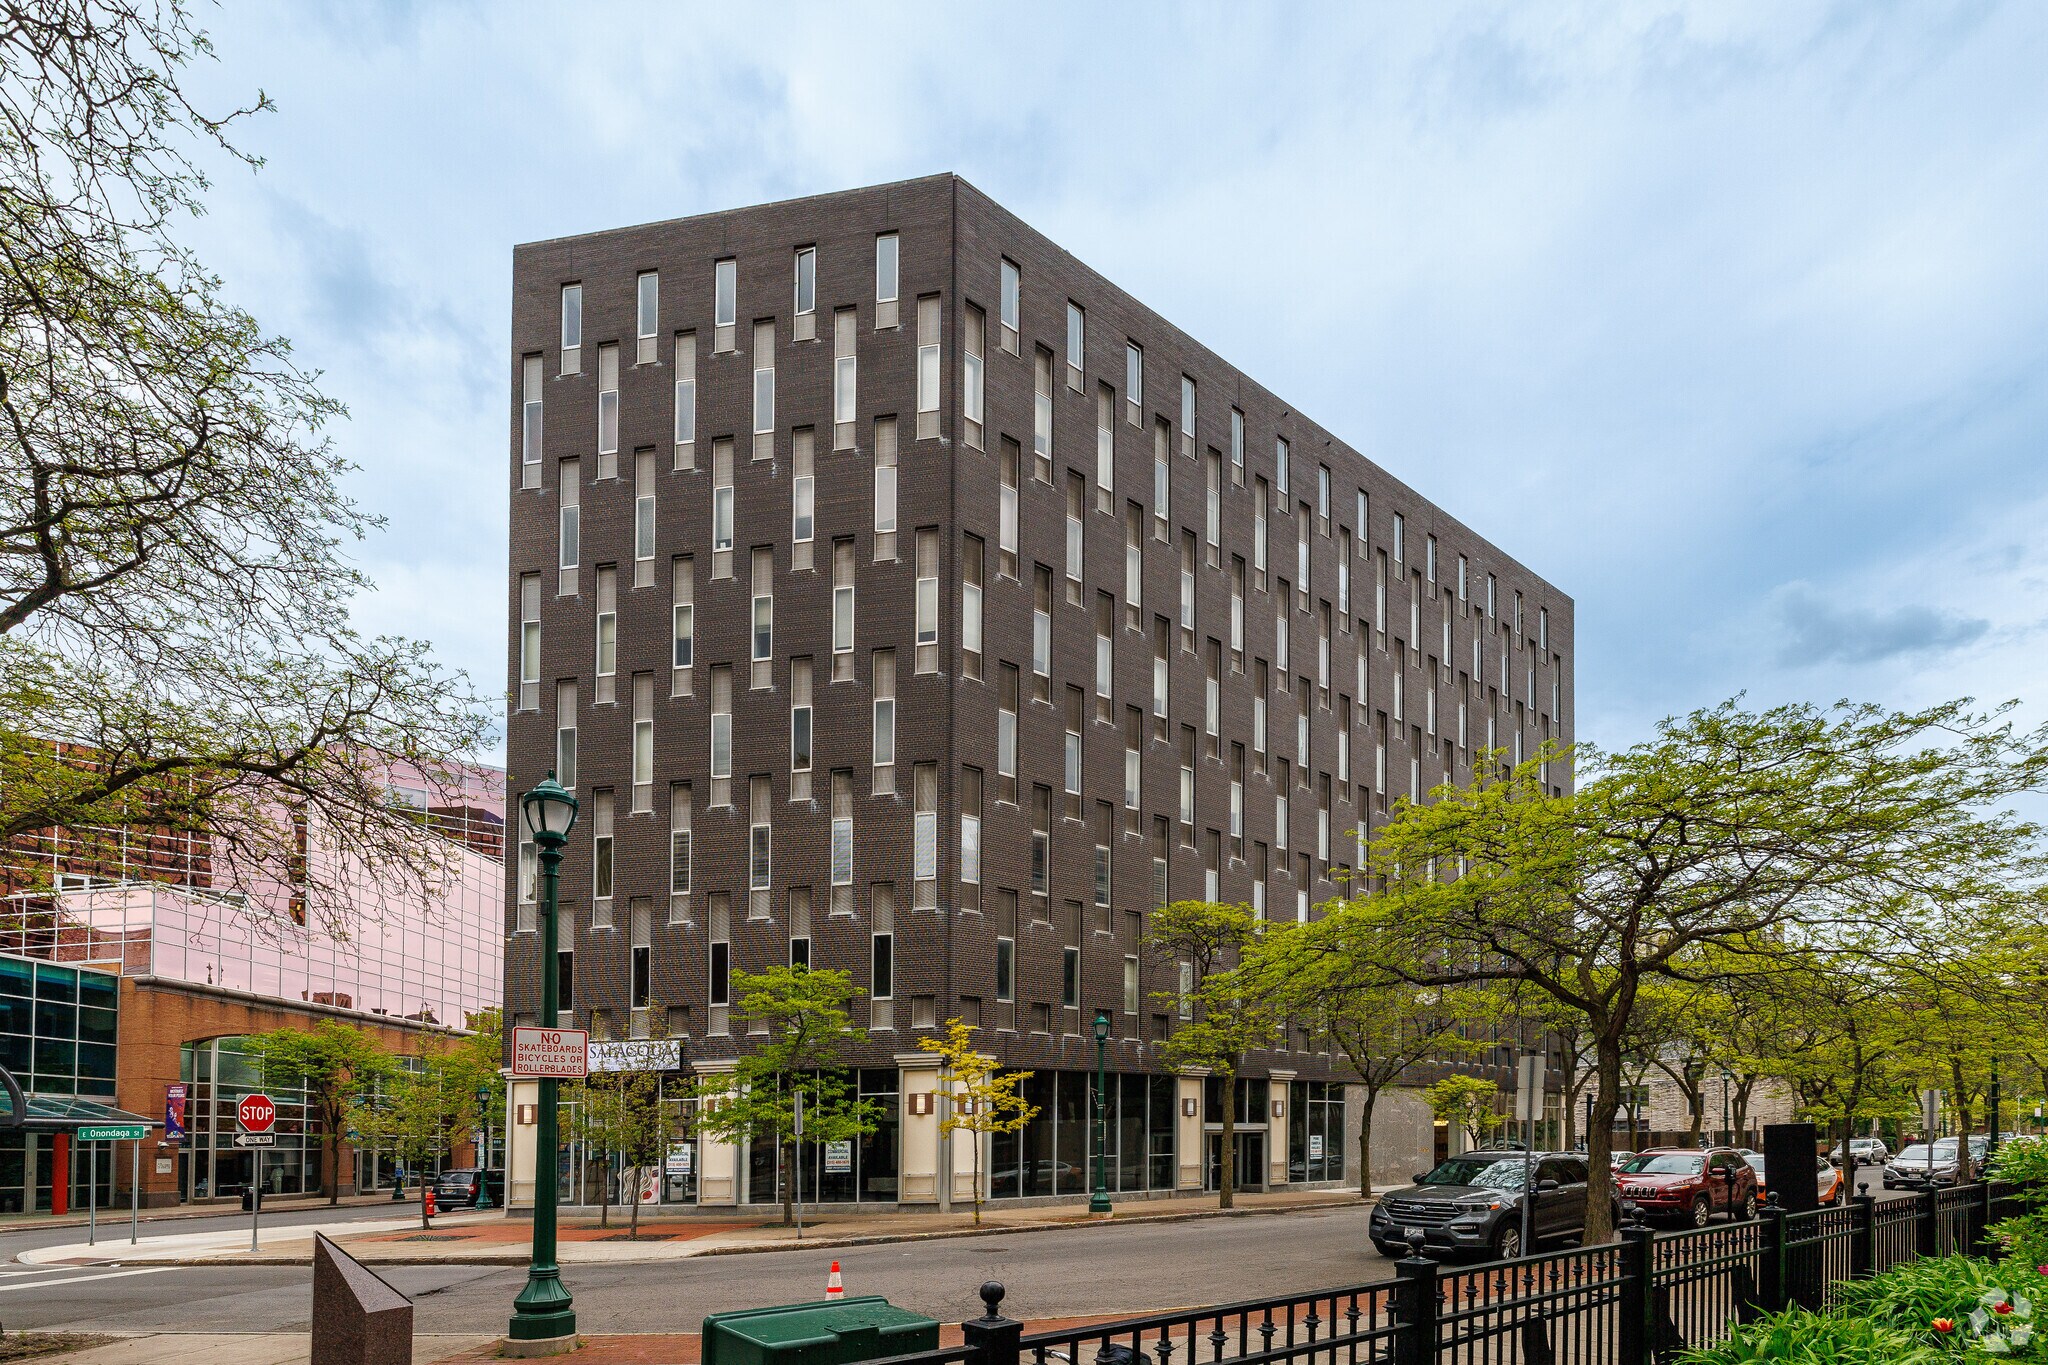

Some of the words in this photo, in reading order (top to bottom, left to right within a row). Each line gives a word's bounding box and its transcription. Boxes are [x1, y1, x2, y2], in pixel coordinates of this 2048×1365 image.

[541, 1032, 561, 1044] NO
[518, 1043, 583, 1053] SKATEBOARDS
[518, 1054, 566, 1062] BICYCLES
[570, 1055, 583, 1063] OR
[517, 1063, 583, 1073] ROLLERBLADES
[242, 1106, 273, 1120] STOP
[90, 1129, 130, 1139] Onondaga
